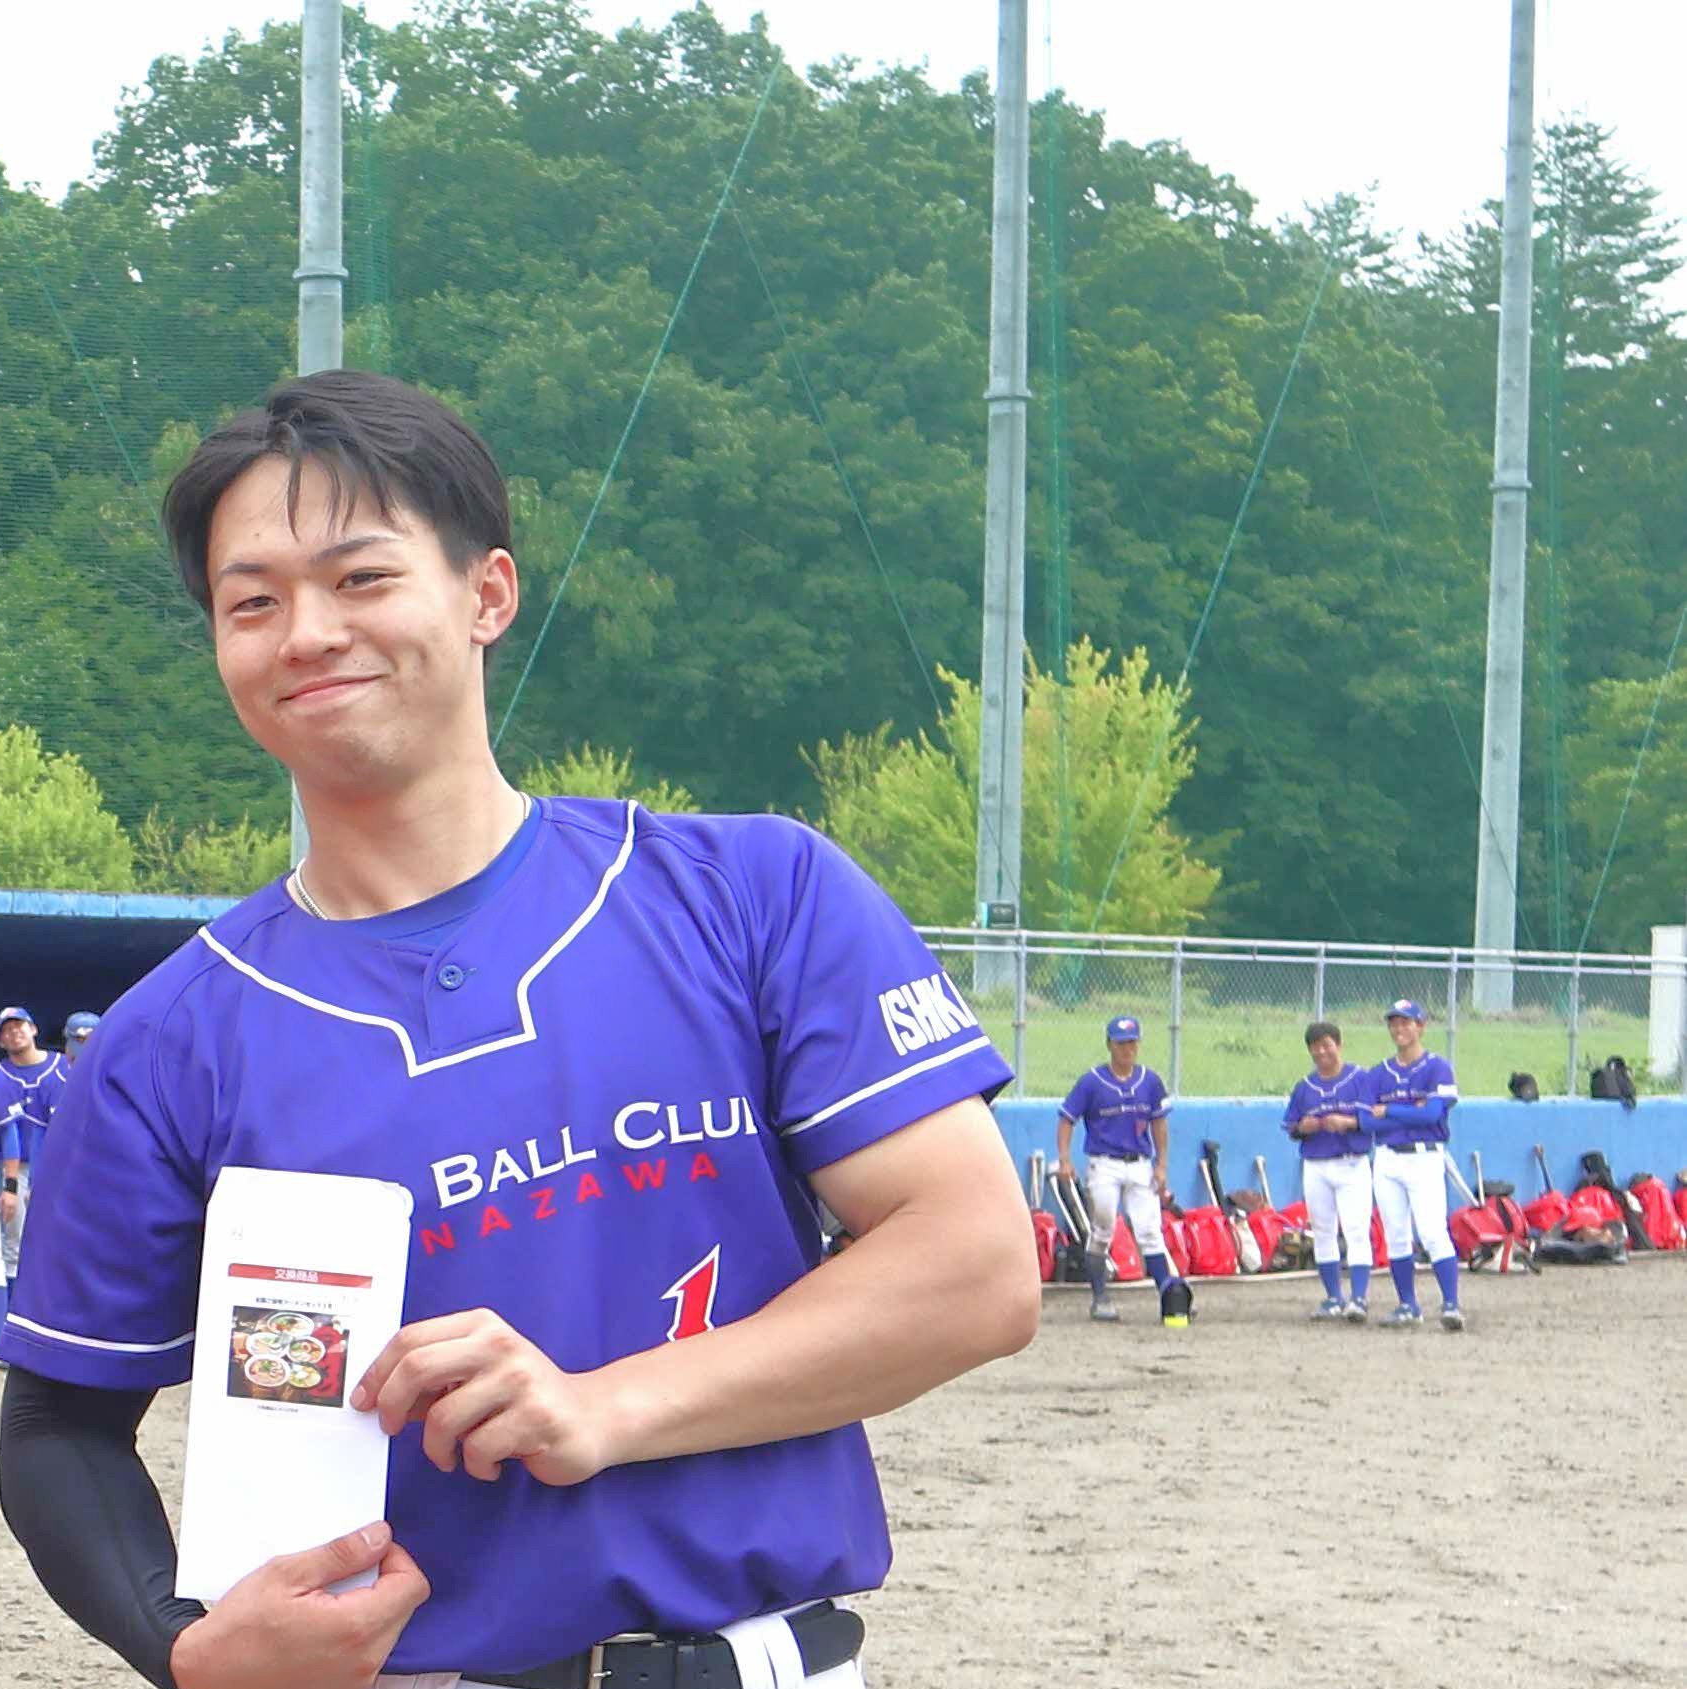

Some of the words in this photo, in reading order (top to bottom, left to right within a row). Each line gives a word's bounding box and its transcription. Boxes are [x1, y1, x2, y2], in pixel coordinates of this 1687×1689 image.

[429, 1126, 597, 1209] BALL
[274, 1268, 320, 1284] 交換商品
[660, 1243, 722, 1342] 1
